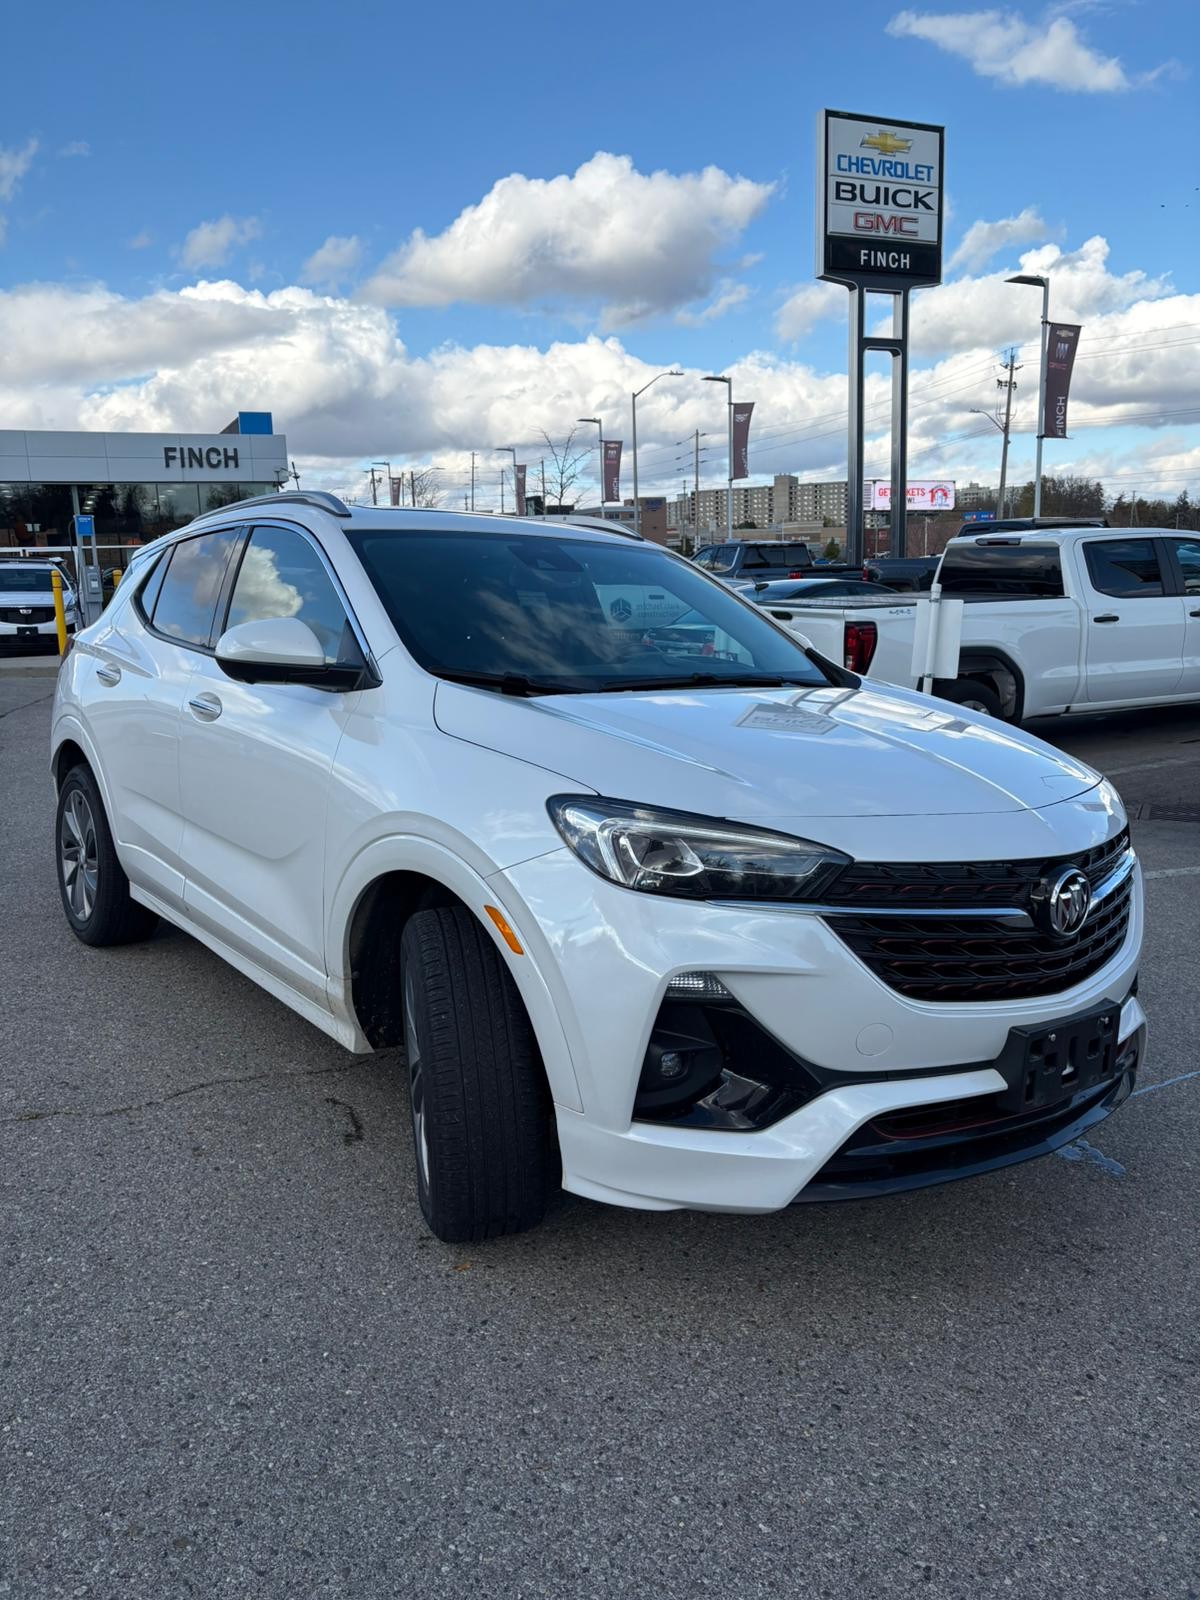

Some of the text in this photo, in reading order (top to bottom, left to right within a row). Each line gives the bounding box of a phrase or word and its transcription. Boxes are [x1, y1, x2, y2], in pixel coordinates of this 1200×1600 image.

[837, 154, 935, 182] CHEVROLET
[835, 181, 935, 211] BUICK
[853, 211, 919, 236] GMC
[860, 249, 910, 269] FINCH
[1056, 396, 1066, 436] FINCH
[163, 446, 239, 469] FINCH
